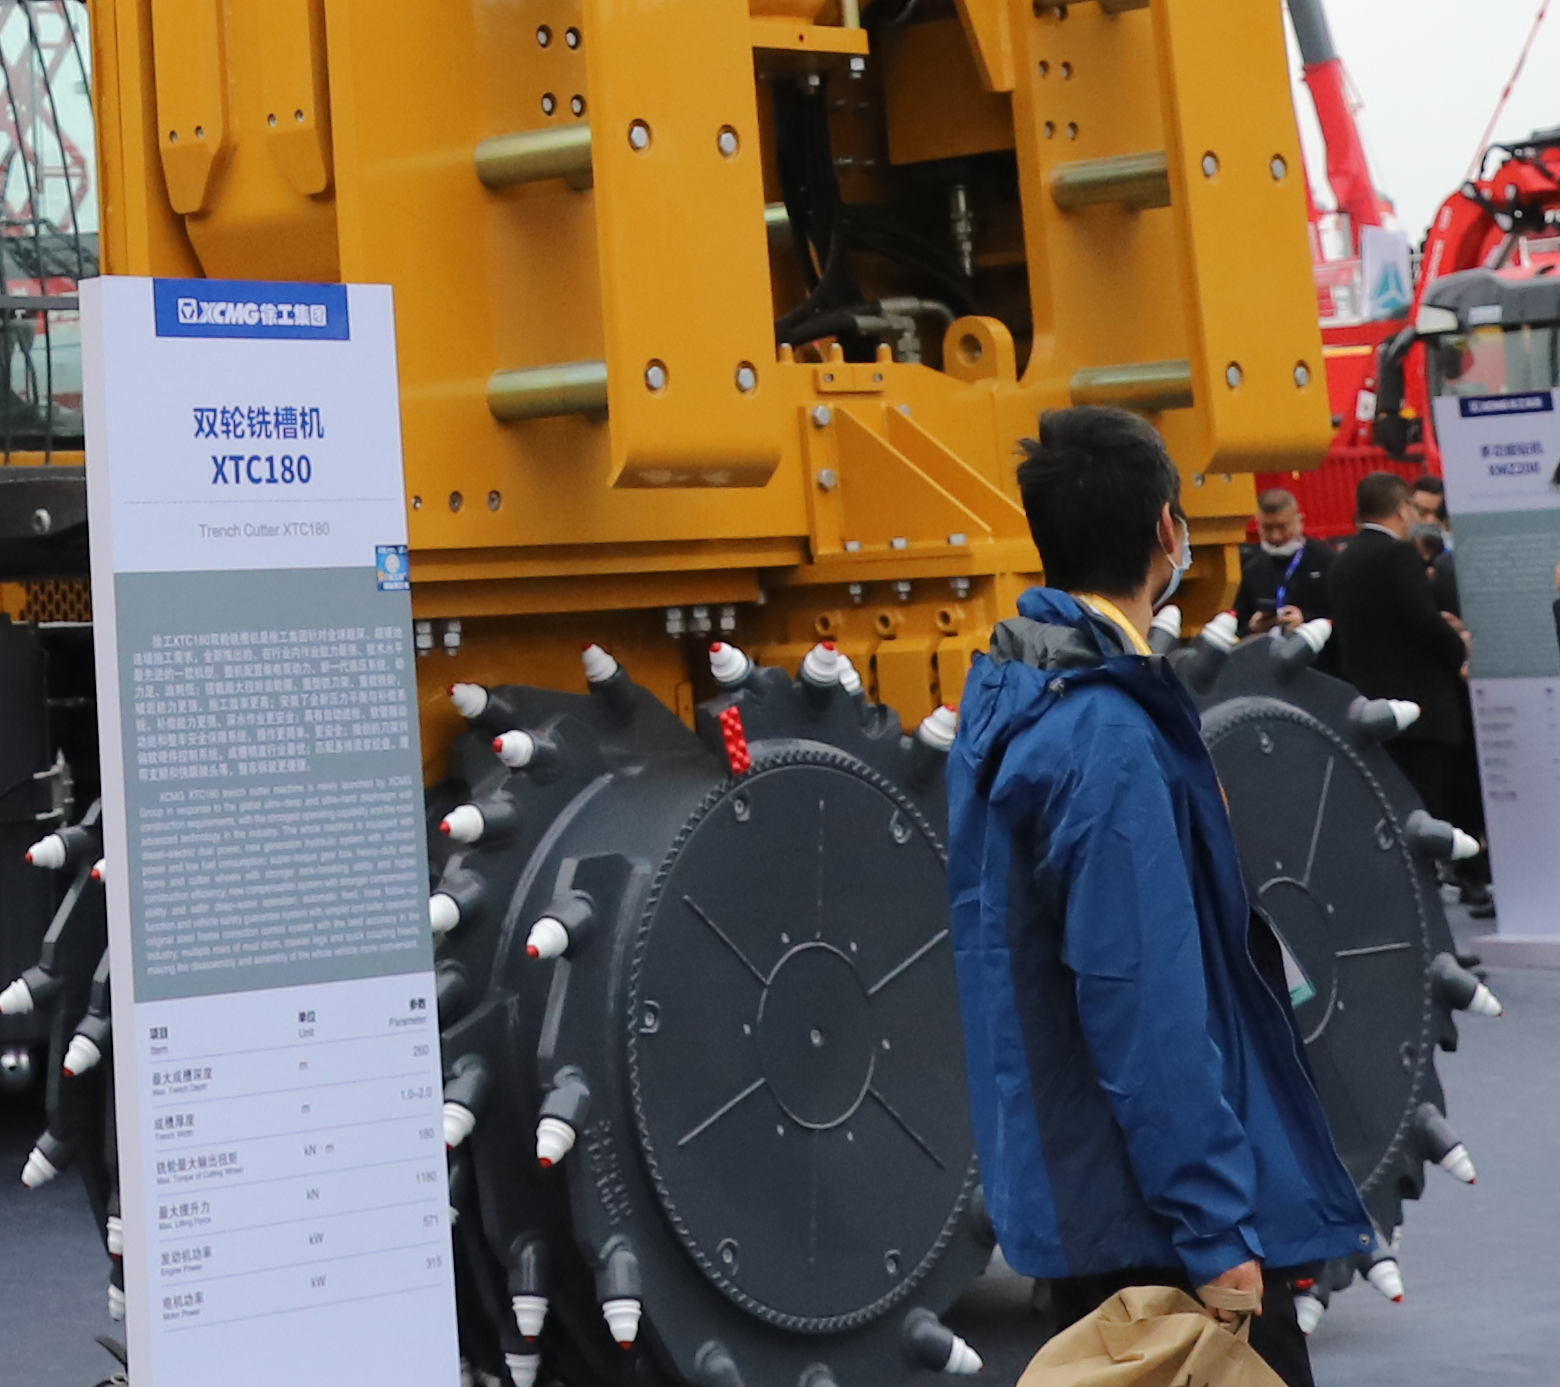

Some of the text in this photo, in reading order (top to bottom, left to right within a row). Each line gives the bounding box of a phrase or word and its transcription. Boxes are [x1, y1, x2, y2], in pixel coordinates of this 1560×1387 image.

[193, 405, 325, 440] 双轮铣槽机
[211, 454, 312, 485] XTC180
[198, 521, 330, 539] Trench Cutter XTC180
[418, 1128, 435, 1140] 180
[416, 1171, 438, 1184] 1180
[306, 1188, 320, 1200] kN
[158, 1200, 211, 1220] 最大提升力
[308, 1232, 324, 1245] kW
[160, 1245, 213, 1267] 发动机功率
[425, 1255, 442, 1269] 315
[311, 1275, 326, 1288] kW
